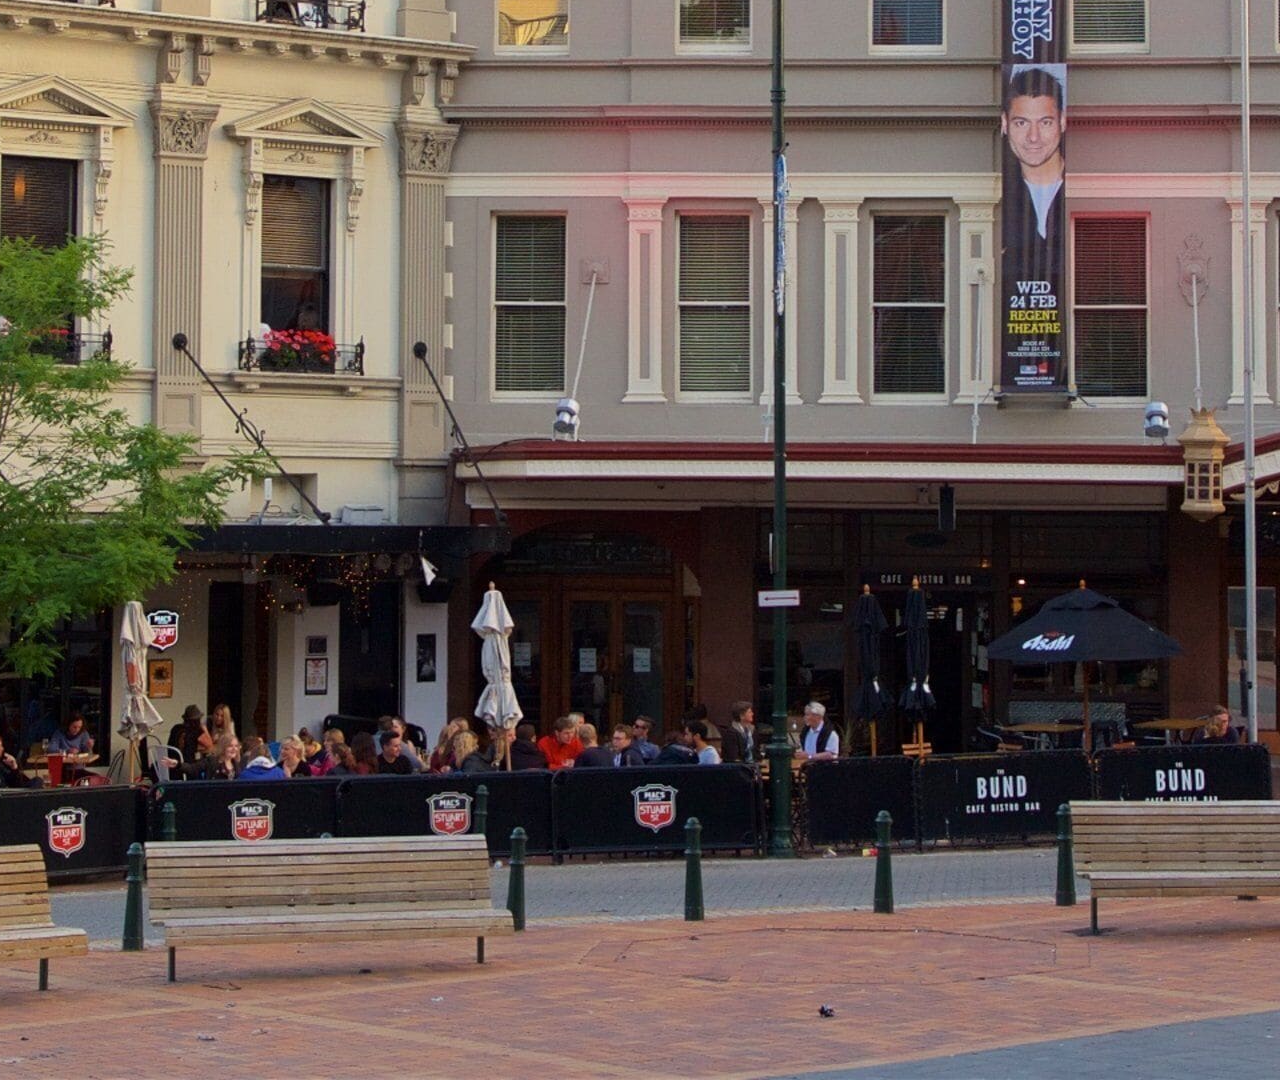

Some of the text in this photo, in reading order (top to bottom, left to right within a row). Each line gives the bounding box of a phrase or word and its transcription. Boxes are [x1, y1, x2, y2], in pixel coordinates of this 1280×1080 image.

[1016, 281, 1051, 294] WED
[1010, 295, 1057, 308] 24 FEB
[1009, 310, 1058, 321] REGENT
[1007, 322, 1061, 334] THEATRE
[880, 574, 902, 584] CAFE
[955, 575, 972, 584] BAR
[1022, 634, 1075, 652] Asahi
[1155, 768, 1205, 793] BUND
[976, 775, 1027, 800] BUND
[639, 804, 671, 814] STUART
[966, 802, 1040, 814] CAFE BISTRO BAR
[236, 819, 268, 829] STUART
[433, 813, 464, 823] STUART
[53, 828, 80, 839] STUART
